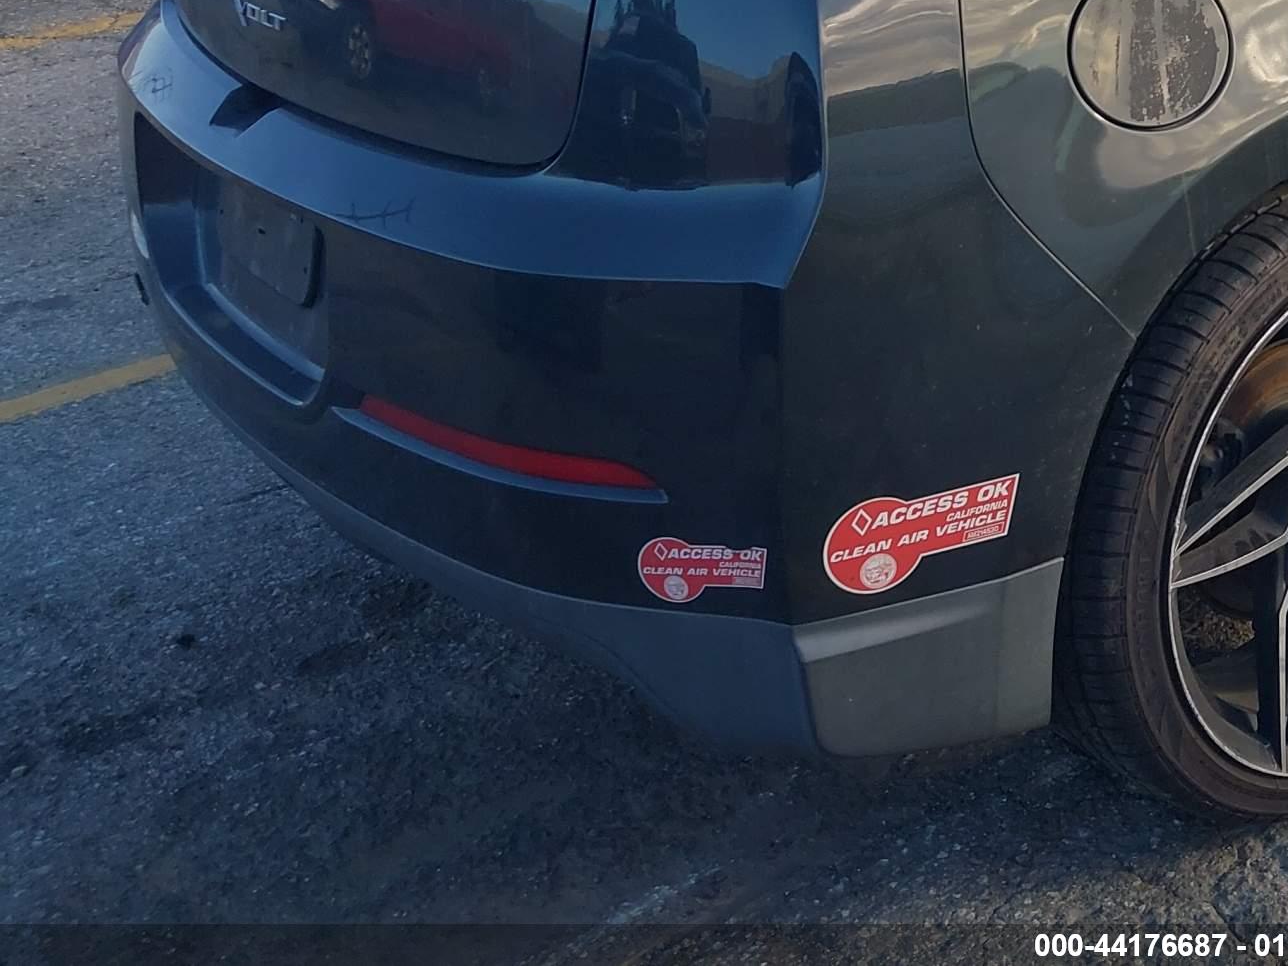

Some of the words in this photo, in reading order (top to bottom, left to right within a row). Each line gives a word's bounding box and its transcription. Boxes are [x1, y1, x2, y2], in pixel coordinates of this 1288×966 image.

[871, 490, 969, 530] ACCESS
[976, 480, 1012, 502] OK
[946, 499, 1009, 522] CALIFORNIA
[830, 538, 893, 563] CLEAN
[897, 529, 930, 547] AIR
[936, 510, 1007, 537] VEHICLE
[668, 548, 733, 560] ACCESS
[740, 549, 762, 561] OK
[643, 566, 683, 575] CLEAN
[687, 567, 709, 576] AIR
[713, 568, 762, 577] VEHICLE
